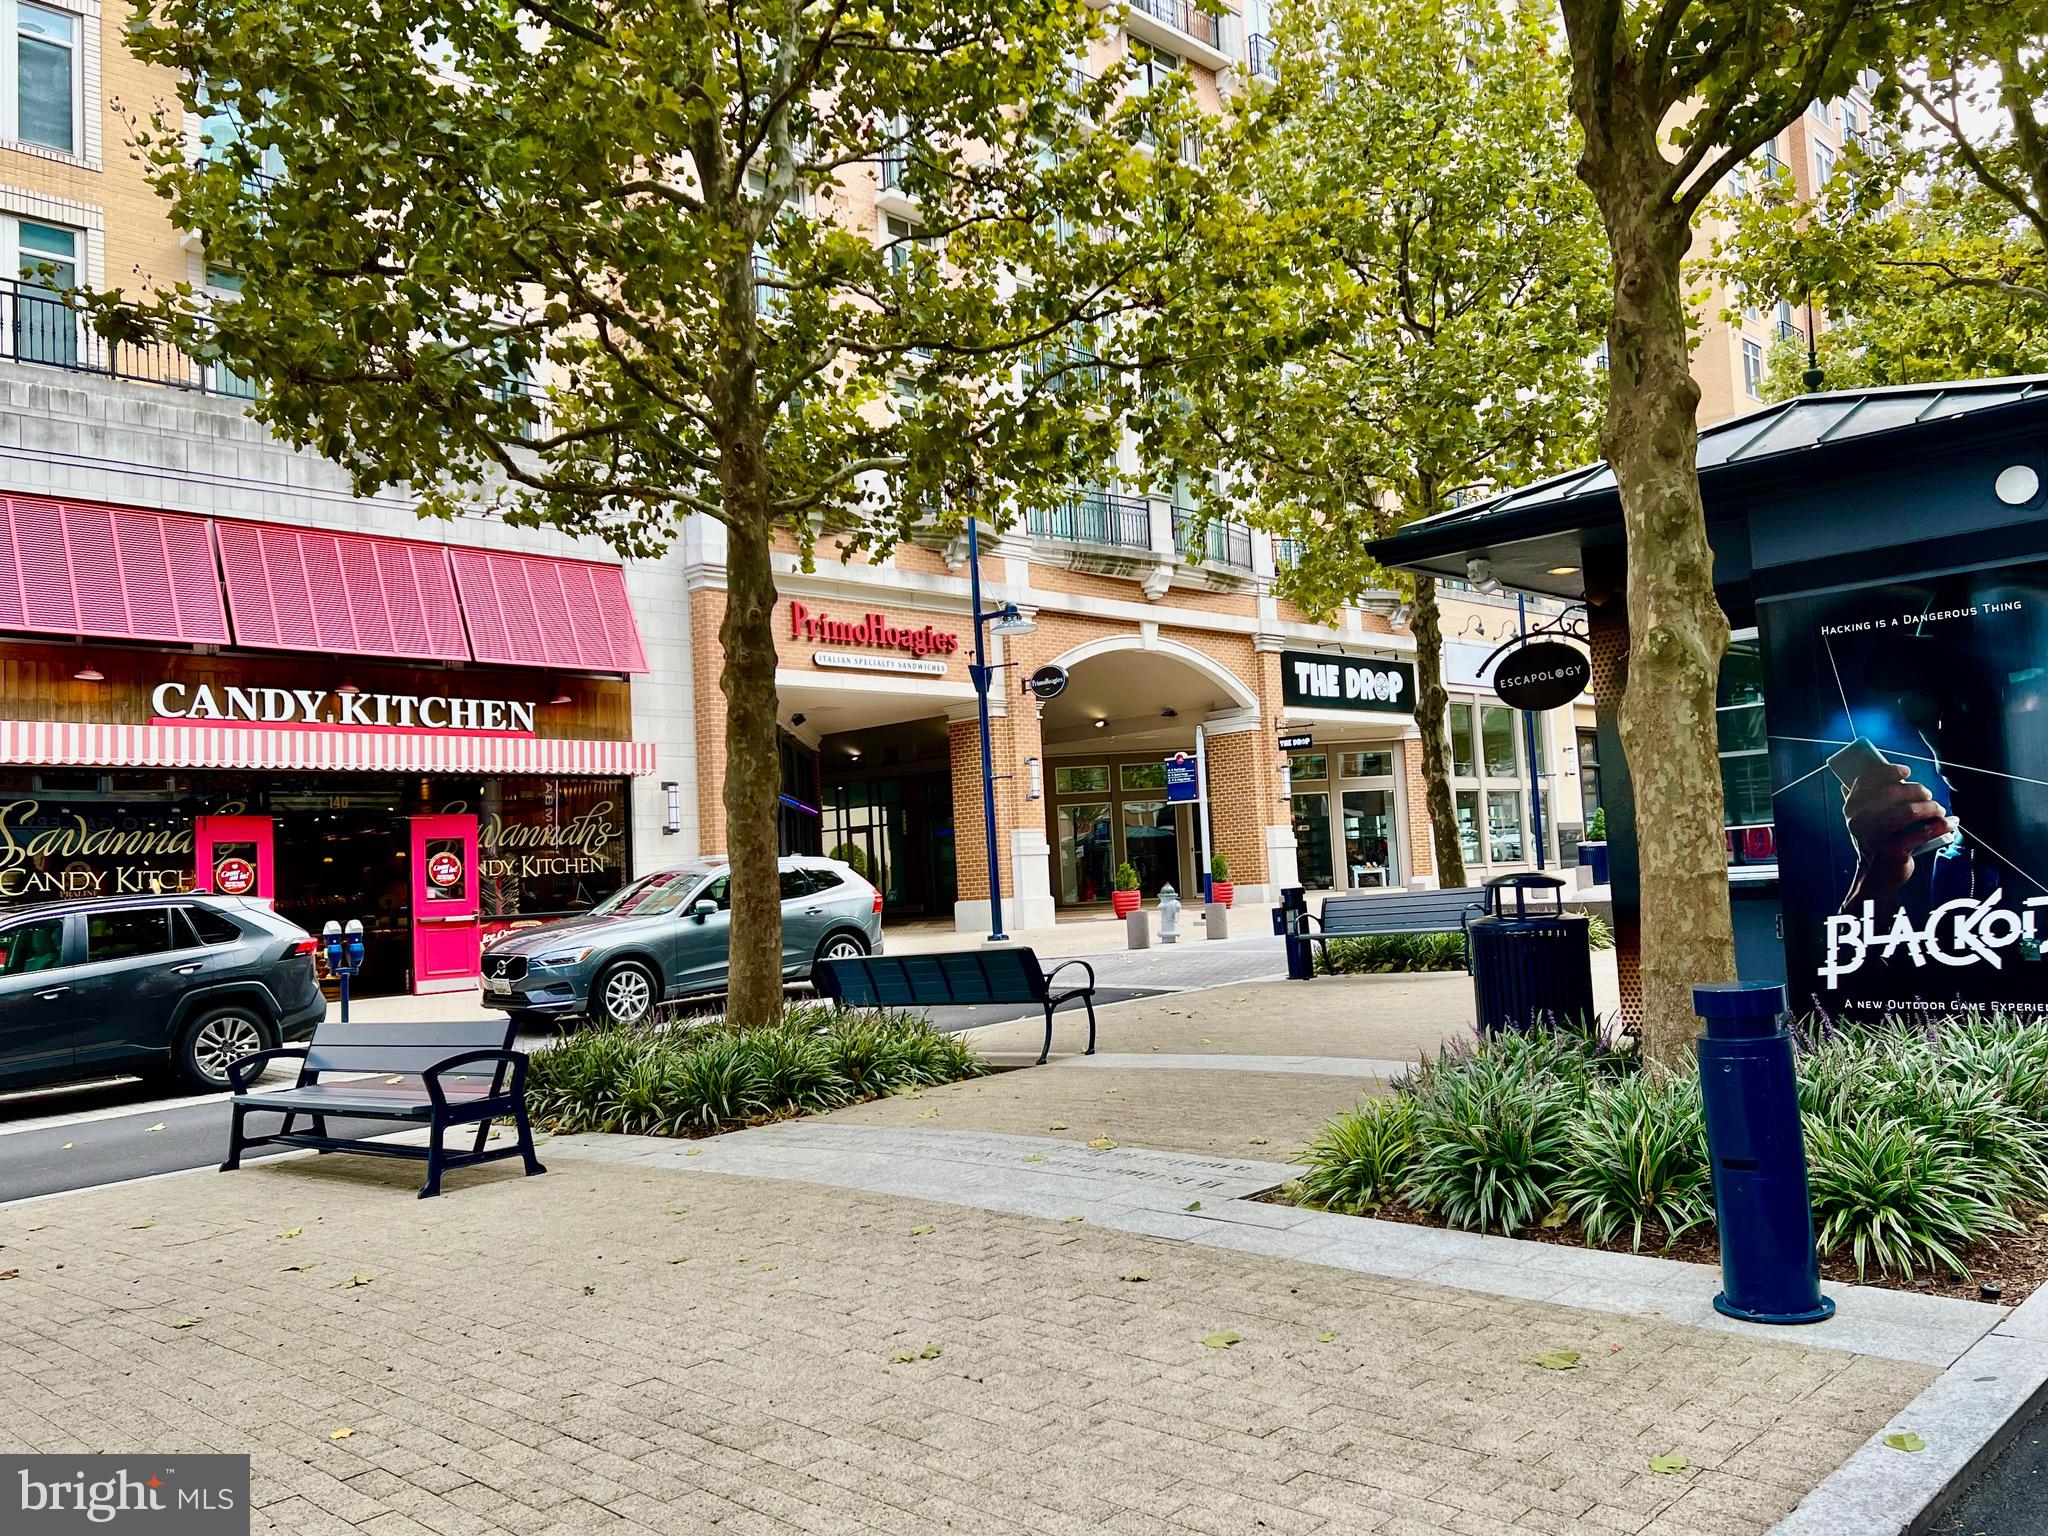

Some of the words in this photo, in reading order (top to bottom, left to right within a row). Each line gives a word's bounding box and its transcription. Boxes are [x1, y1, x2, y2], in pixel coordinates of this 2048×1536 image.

[791, 601, 959, 656] PrimoHoagies
[1821, 622, 1871, 636] HACKING
[1875, 619, 1886, 628] IS
[1891, 618, 1899, 626] A
[1903, 607, 1978, 625] DANGEROUS
[1982, 600, 2022, 614] THING
[818, 655, 851, 664] ITALIAN
[854, 657, 895, 668] SPECIALTY
[898, 661, 945, 672] SANDWICHES
[1500, 665, 1581, 688] ESCAPOLOGY
[1294, 661, 1340, 697] THE
[1345, 667, 1404, 702] DROP
[151, 682, 327, 722] CANDY
[336, 692, 536, 732] KITCHEN
[1280, 739, 1292, 748] THE
[521, 855, 604, 878] KITCHEN
[0, 867, 107, 896] CANDY
[116, 866, 195, 893] KITCH
[1844, 999, 1853, 1008] A
[1857, 1001, 1883, 1009] NEW
[1887, 1000, 1946, 1010] OUTDOOR
[1950, 1000, 1986, 1011] GAME
